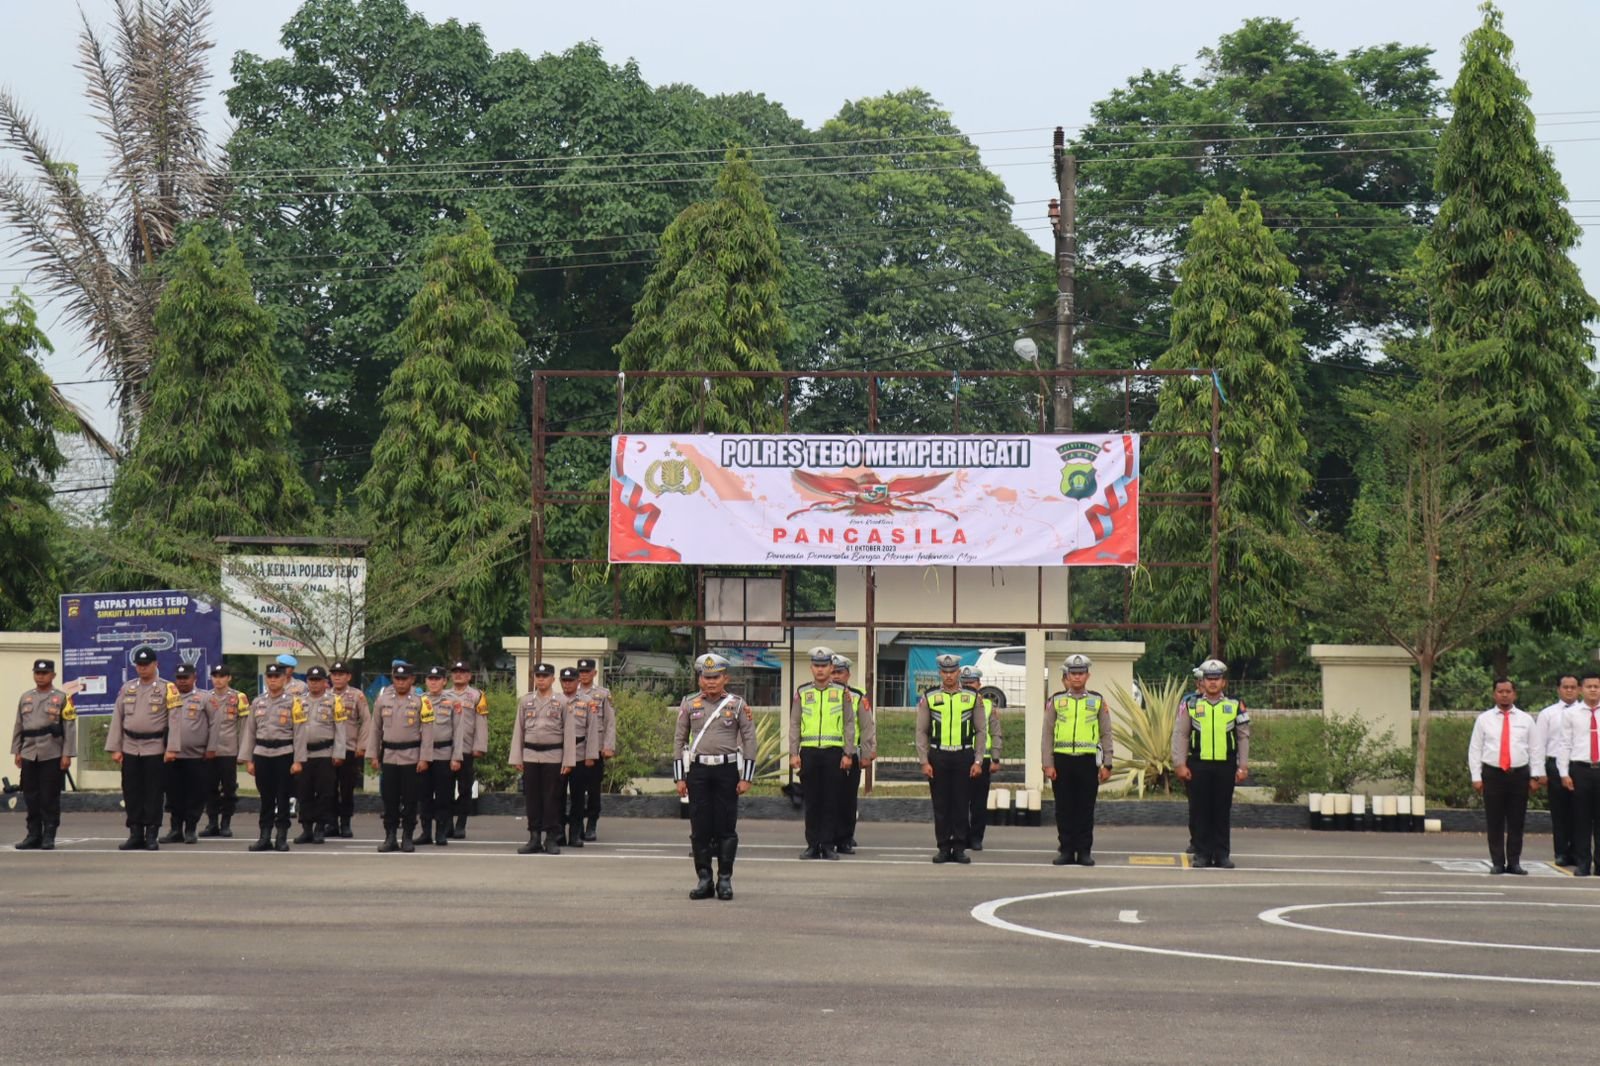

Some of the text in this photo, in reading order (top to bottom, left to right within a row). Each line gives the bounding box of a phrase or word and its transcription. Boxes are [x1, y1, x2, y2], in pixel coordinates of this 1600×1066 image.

[722, 439, 1030, 468] POLRES TEBO MEMPERINGATI
[772, 527, 967, 544] PANCASILA
[267, 563, 297, 577] KERJA
[299, 564, 333, 578] POLRES
[335, 565, 359, 578] TEBO
[94, 596, 189, 610] SATPAS POLRES TEBO
[97, 610, 123, 618] SIRKUIT
[124, 609, 135, 617] UJI
[136, 608, 165, 616] PRAKTEK
[167, 607, 180, 615] SIM
